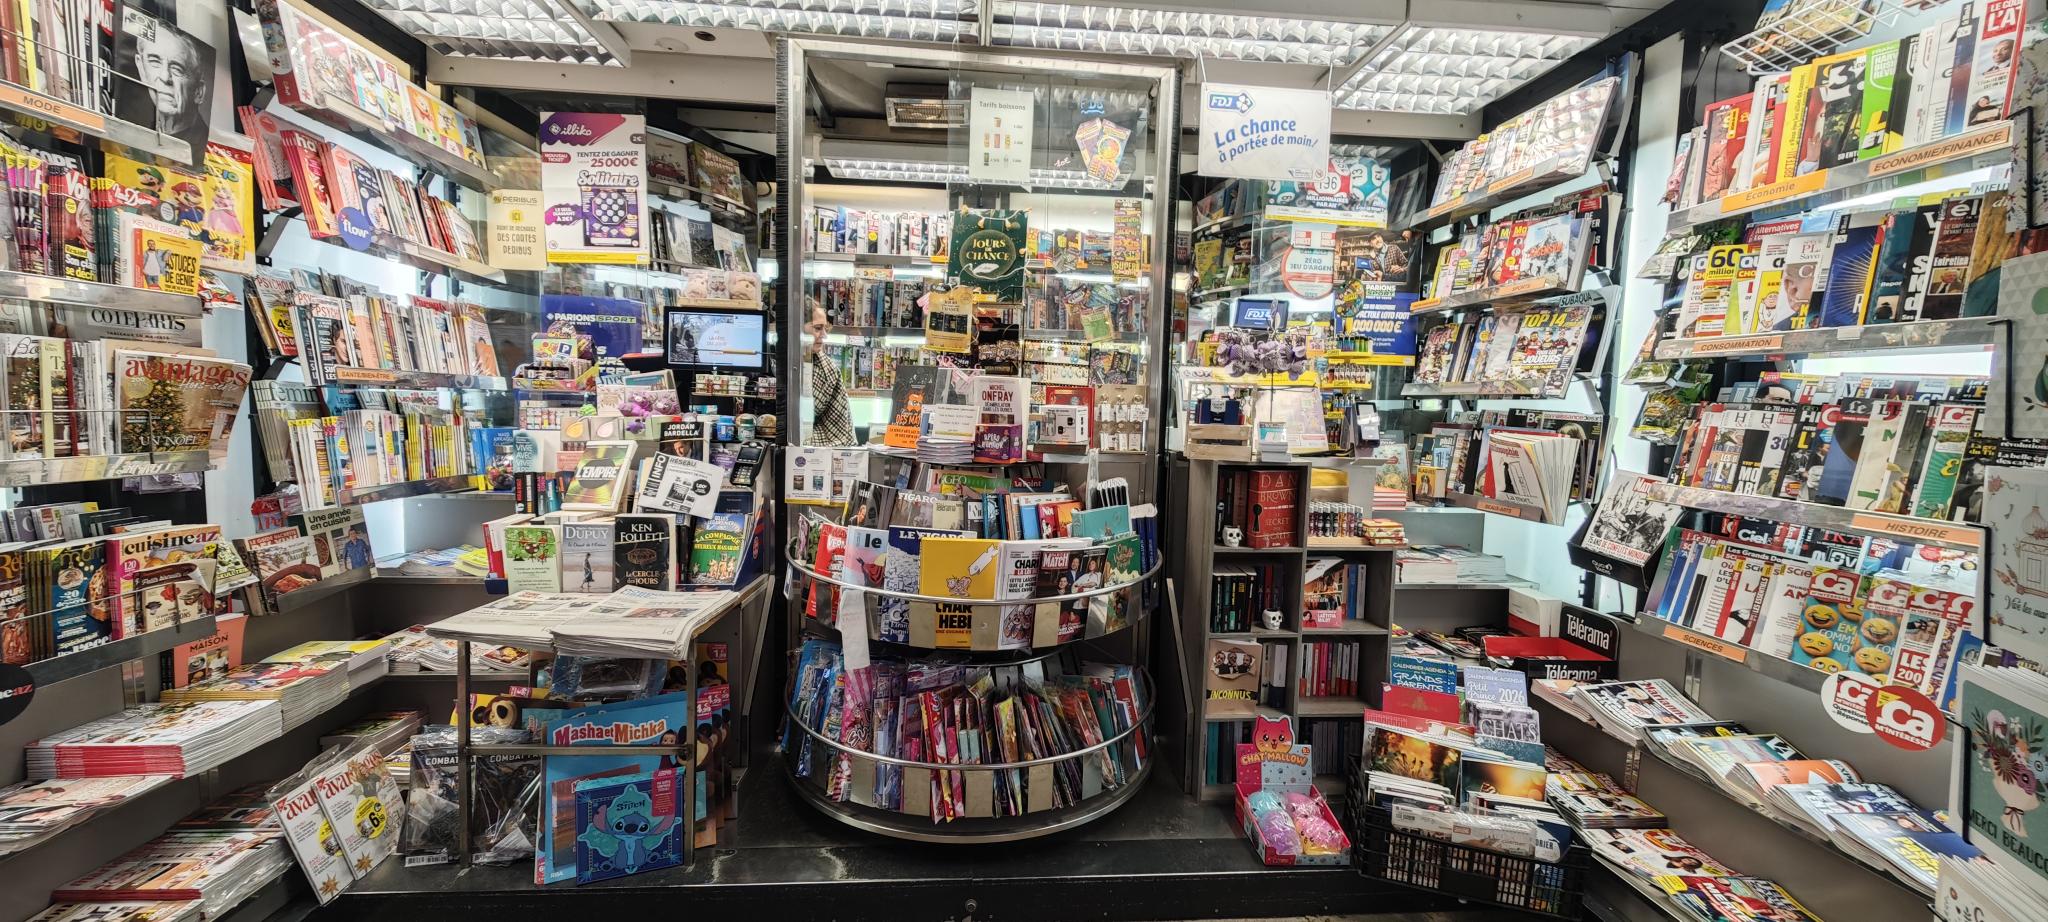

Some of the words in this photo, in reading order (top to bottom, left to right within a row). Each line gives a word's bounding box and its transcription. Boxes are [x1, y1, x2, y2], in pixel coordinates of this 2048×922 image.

[23, 95, 62, 115] MODE
[980, 101, 998, 109] Tarifs
[998, 102, 1026, 111] boissons
[1210, 95, 1233, 107] FDJ
[560, 122, 593, 136] illiko
[1214, 128, 1236, 149] La
[1240, 119, 1297, 138] chance
[1218, 150, 1227, 163] à
[1229, 135, 1268, 161] portée
[1270, 134, 1284, 145] de
[1286, 135, 1319, 148] main!
[1873, 130, 2004, 173] ECONOMIE/FINANCE
[577, 169, 640, 188] Solitaire
[1305, 194, 1349, 204] MILLIONNAIRES
[343, 220, 369, 239] flow
[1755, 222, 1800, 235] Alternatives
[973, 239, 1006, 249] JOURS
[966, 251, 1010, 261] CHANCE
[165, 254, 197, 274] ASTUCES
[165, 273, 175, 283] DE
[554, 313, 597, 322] PARIONS
[597, 315, 637, 324] SPORT
[1246, 309, 1266, 319] FDJ
[1523, 313, 1550, 328] TOP
[1549, 311, 1568, 328] 14
[1700, 339, 1772, 352] CONSOMMATION
[1522, 353, 1562, 364] JOUEURS
[125, 358, 250, 386] avantages
[981, 390, 1014, 401] ONFRAY
[667, 423, 696, 431] JORDAN
[575, 465, 617, 479] L'EMPIRE
[651, 455, 667, 479] INFO
[1261, 474, 1298, 488] DAN
[898, 493, 937, 504] FIGARO
[1260, 490, 1297, 502] BROWN
[308, 515, 327, 524] Une
[327, 508, 351, 520] année
[310, 523, 322, 531] en
[322, 516, 351, 528] cuisine
[630, 523, 653, 533] KEN
[565, 526, 609, 541] DUPUY
[620, 531, 665, 543] FOLLETT
[1737, 528, 1768, 545] Ciel
[1885, 522, 1949, 540] HISTOIRE
[864, 533, 881, 548] le
[1727, 546, 1740, 554] Les
[1743, 549, 1770, 561] Grands
[1042, 556, 1069, 569] MATCH
[632, 570, 660, 578] CERCLE
[634, 577, 660, 586] JOURS
[1566, 613, 1610, 650] Télérama
[189, 634, 230, 653] MAISON
[1683, 633, 1724, 653] SCIENCES
[1392, 662, 1447, 674] CALENDRIER-AGENDA
[1545, 664, 1598, 680] Télérama
[1897, 668, 1922, 684] 200
[1397, 680, 1444, 693] PARENTS
[1466, 680, 1489, 692] Petit
[1210, 689, 1252, 700] INCONNUS
[1466, 691, 1497, 701] Prince
[1498, 687, 1525, 705] 2026
[1642, 681, 1690, 721] Marianne
[553, 724, 604, 747] Masha
[613, 719, 668, 745] Michka
[1479, 717, 1537, 742] CHATS
[1875, 723, 1933, 749] M'INTÉRESSE
[425, 757, 459, 766] COMBAT
[1241, 752, 1309, 767] CHAT'MALLOW
[2002, 834, 2048, 876] BEAUCO
